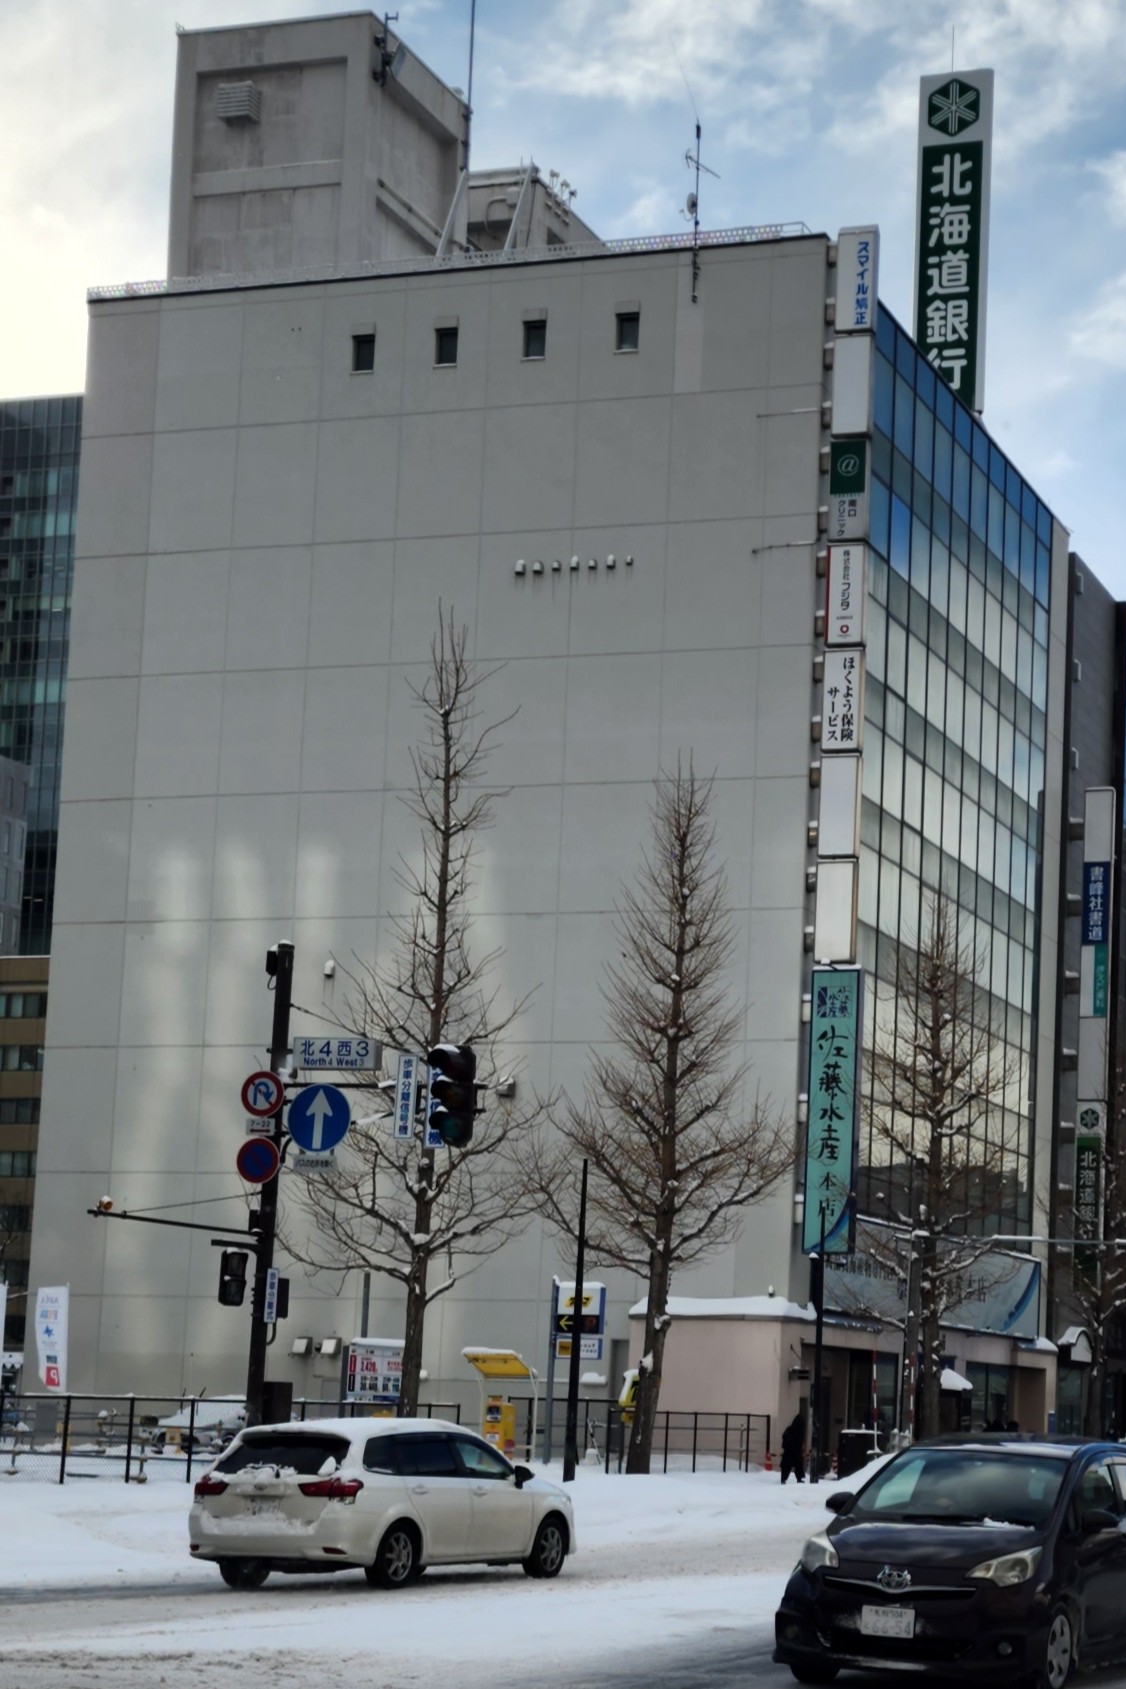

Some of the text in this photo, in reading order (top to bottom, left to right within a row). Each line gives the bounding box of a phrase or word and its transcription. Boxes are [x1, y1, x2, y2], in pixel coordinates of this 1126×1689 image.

[926, 153, 972, 390] 北海道銀行
[837, 500, 846, 536] クリニック
[828, 686, 840, 741] サービス
[841, 657, 855, 742] ほくよう保険
[300, 1040, 369, 1057] 北4西3
[304, 1057, 326, 1066] North
[328, 1058, 333, 1066] 4
[336, 1057, 358, 1066] West
[399, 1059, 413, 1136] 歩車分離信号機
[817, 1025, 849, 1161] 佐藤水産
